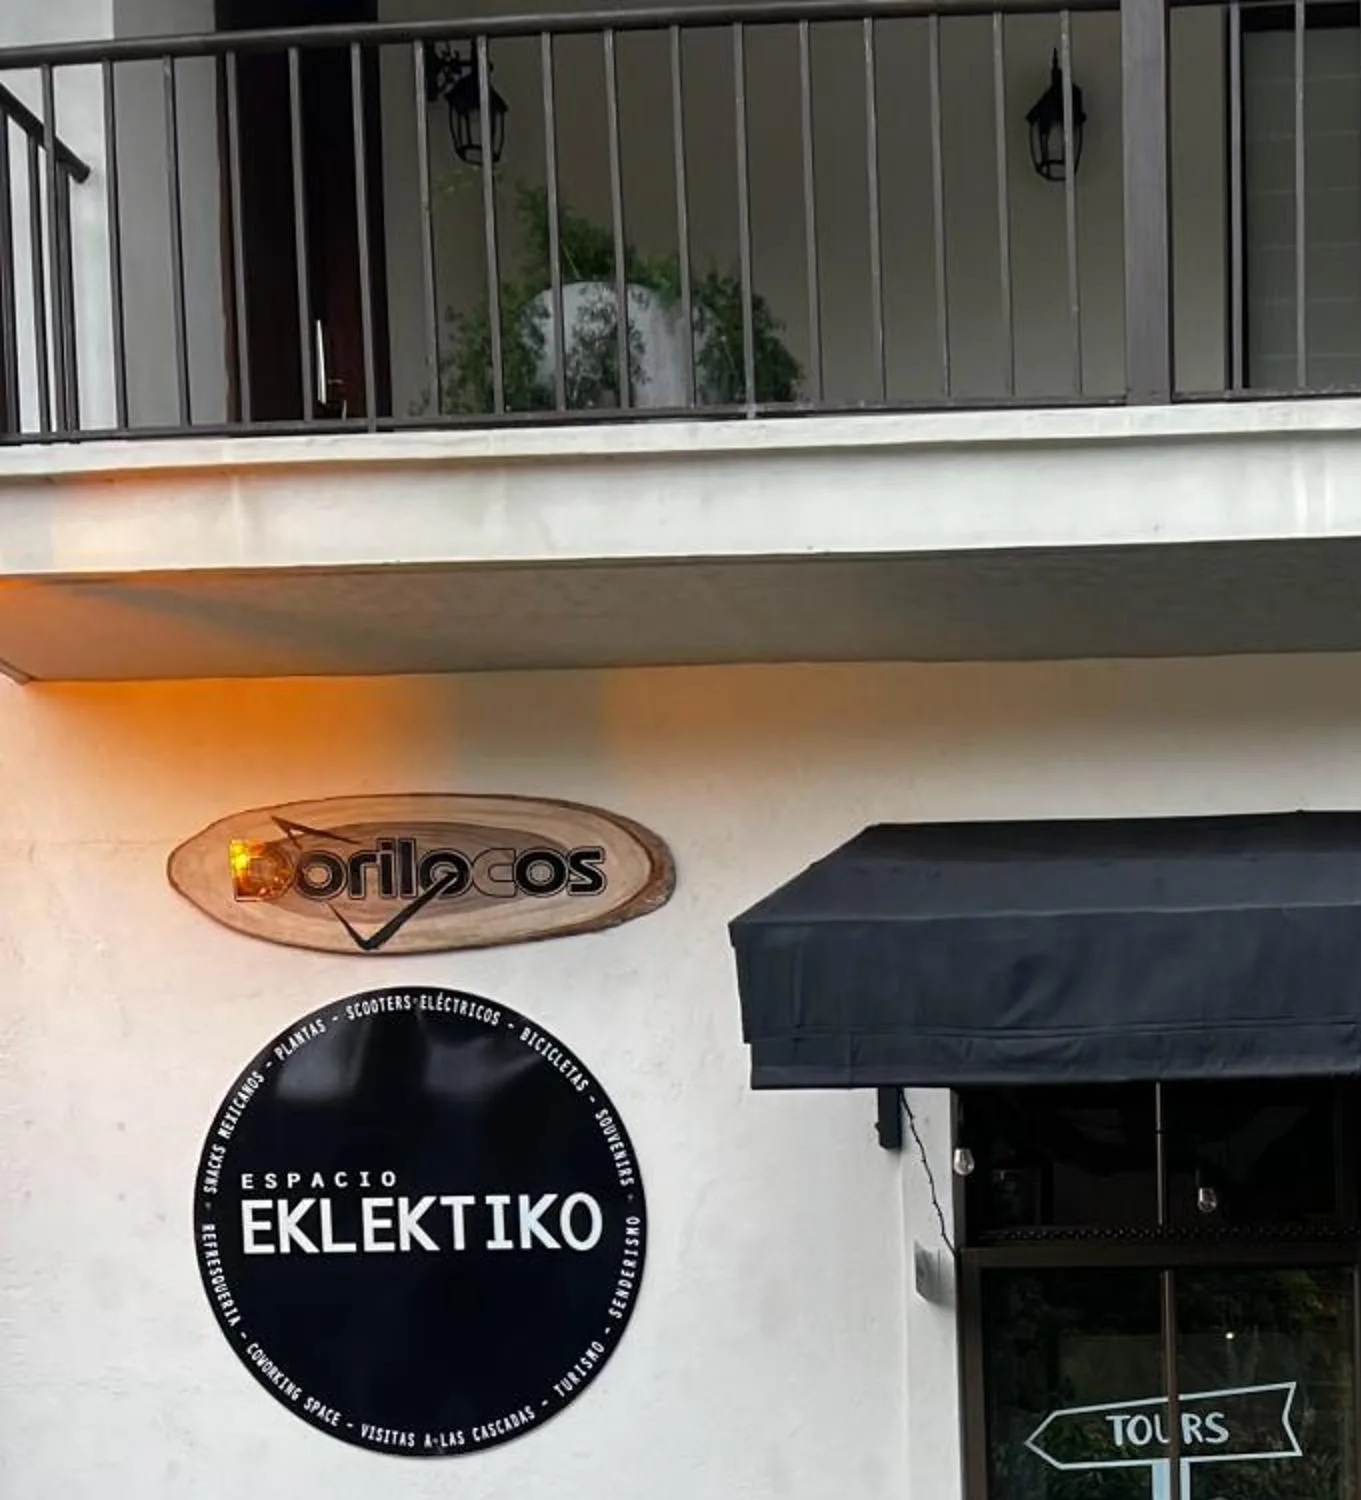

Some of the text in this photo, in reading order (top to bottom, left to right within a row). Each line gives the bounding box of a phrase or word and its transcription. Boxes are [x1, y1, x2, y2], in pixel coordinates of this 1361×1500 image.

[274, 1019, 326, 1060] PLANTAS
[347, 992, 500, 1026] SCOOTERS ELÉCTRICOS
[520, 1027, 589, 1091] BICICLETAS
[204, 1071, 264, 1194] SNACKS MEXICANOS
[595, 1109, 634, 1186] SOUVENIRS
[241, 1171, 396, 1189] ESPACIO
[240, 1192, 603, 1255] EKLEKTIKO
[202, 1224, 241, 1326] REFRESQUERIA
[609, 1216, 641, 1319] SENDERISMO
[247, 1343, 342, 1427] COWORKING SPACE
[553, 1341, 605, 1397] TURISMO
[361, 1424, 415, 1447] VISITAS
[440, 1431, 465, 1447] LAS
[472, 1405, 536, 1442] CASCADAS
